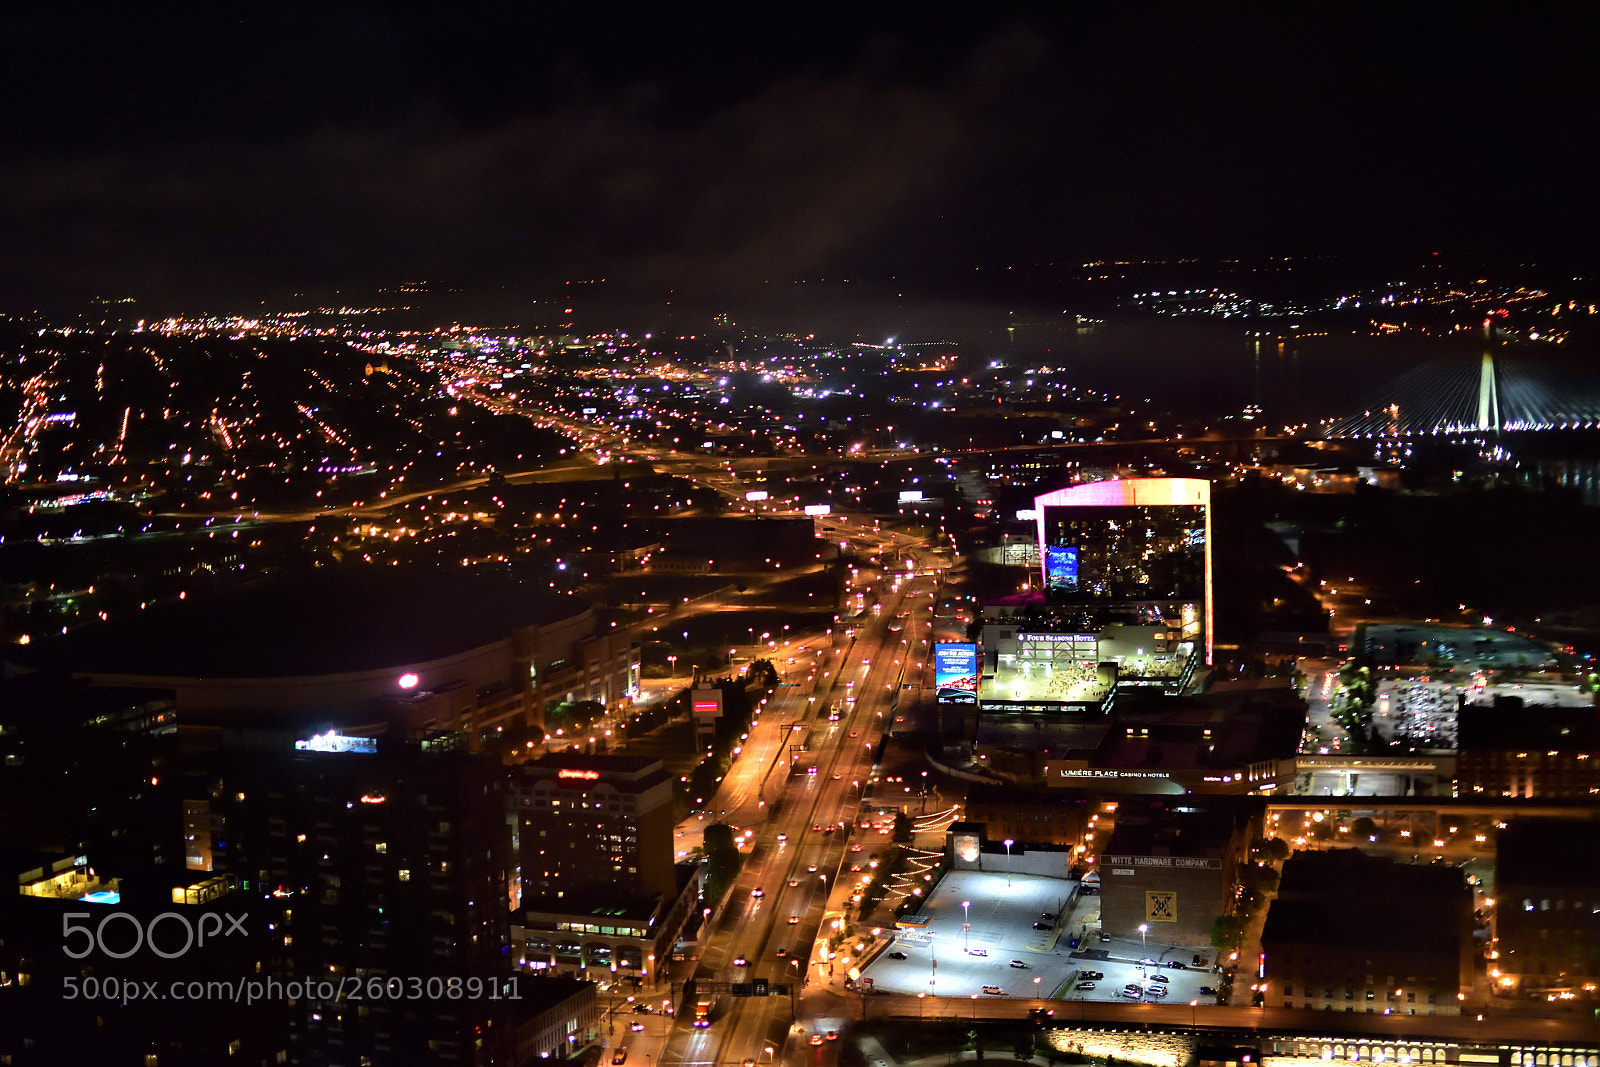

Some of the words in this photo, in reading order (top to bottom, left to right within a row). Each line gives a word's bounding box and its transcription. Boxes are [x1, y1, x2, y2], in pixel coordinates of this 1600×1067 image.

[1027, 634, 1045, 642] FOUR
[1045, 634, 1073, 642] SEASONS
[1074, 634, 1096, 642] HOTEL
[1094, 770, 1118, 778] PLACE
[1111, 855, 1132, 865] WITTE
[1134, 857, 1172, 866] HARDWARE
